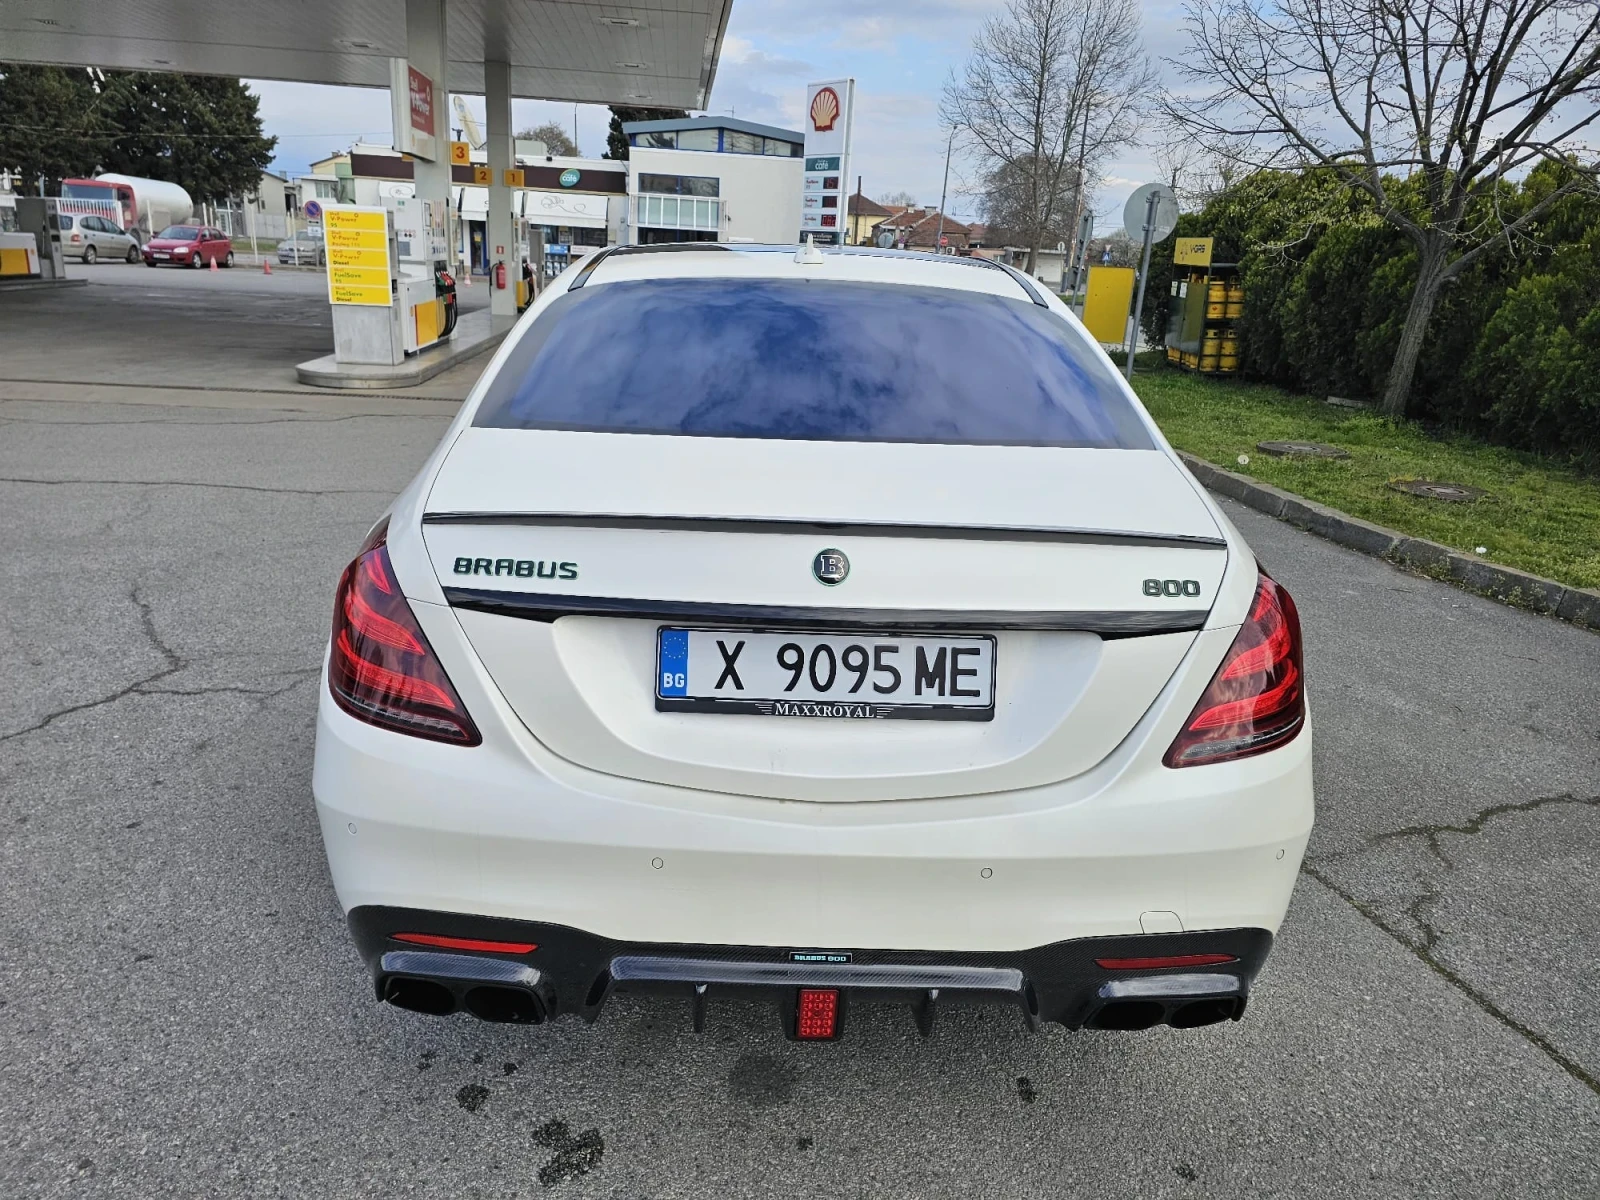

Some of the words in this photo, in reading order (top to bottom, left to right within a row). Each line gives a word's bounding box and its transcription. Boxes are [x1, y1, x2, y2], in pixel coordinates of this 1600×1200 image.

[456, 146, 465, 159] 3
[480, 171, 487, 181] 2
[511, 173, 516, 182] 1
[453, 557, 579, 580] BRABUS
[663, 672, 685, 688] BG
[714, 640, 746, 690] X
[776, 642, 902, 695] 9095
[914, 645, 981, 697] ME
[774, 702, 875, 718] MAXXROYAL
